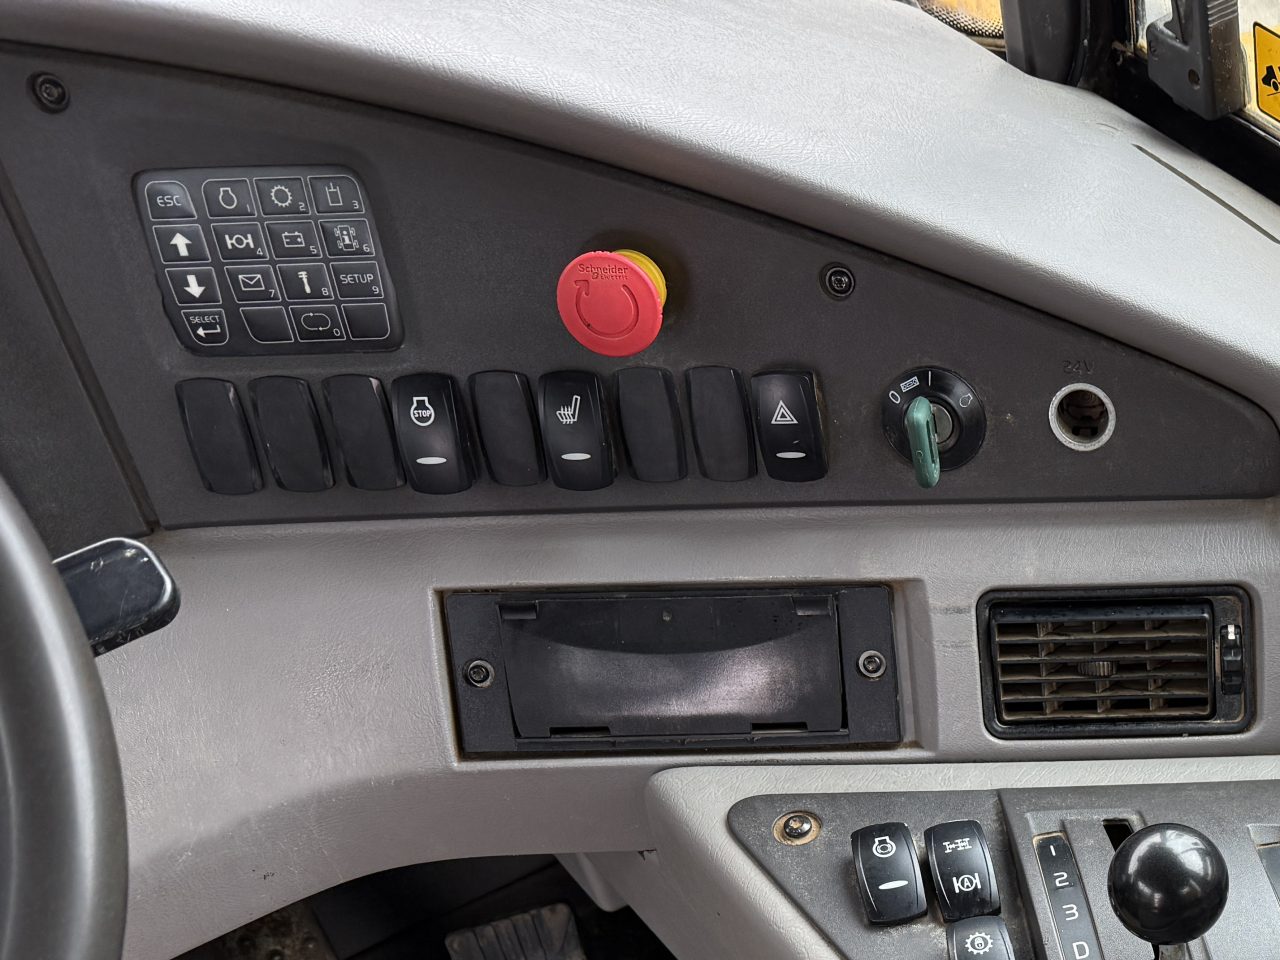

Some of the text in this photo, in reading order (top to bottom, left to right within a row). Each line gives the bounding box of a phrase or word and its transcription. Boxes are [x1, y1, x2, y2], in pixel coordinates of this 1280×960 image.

[156, 195, 182, 207] ESC
[352, 200, 360, 210] 3
[298, 202, 307, 212] 2
[256, 247, 263, 256] 4
[309, 245, 317, 255] 5
[362, 243, 370, 253] 6
[578, 263, 629, 275] Schneider
[339, 273, 374, 285] SETUP
[269, 289, 275, 298] 7
[321, 287, 329, 297] 8
[372, 285, 379, 295] 9
[190, 315, 220, 324] SELECT
[333, 328, 341, 338] 0
[1062, 359, 1096, 376] 24V
[413, 410, 431, 418] STOP
[1049, 845, 1056, 857] 1
[1053, 872, 1069, 887] 2
[1062, 904, 1079, 921] 3
[1072, 941, 1090, 960] D
